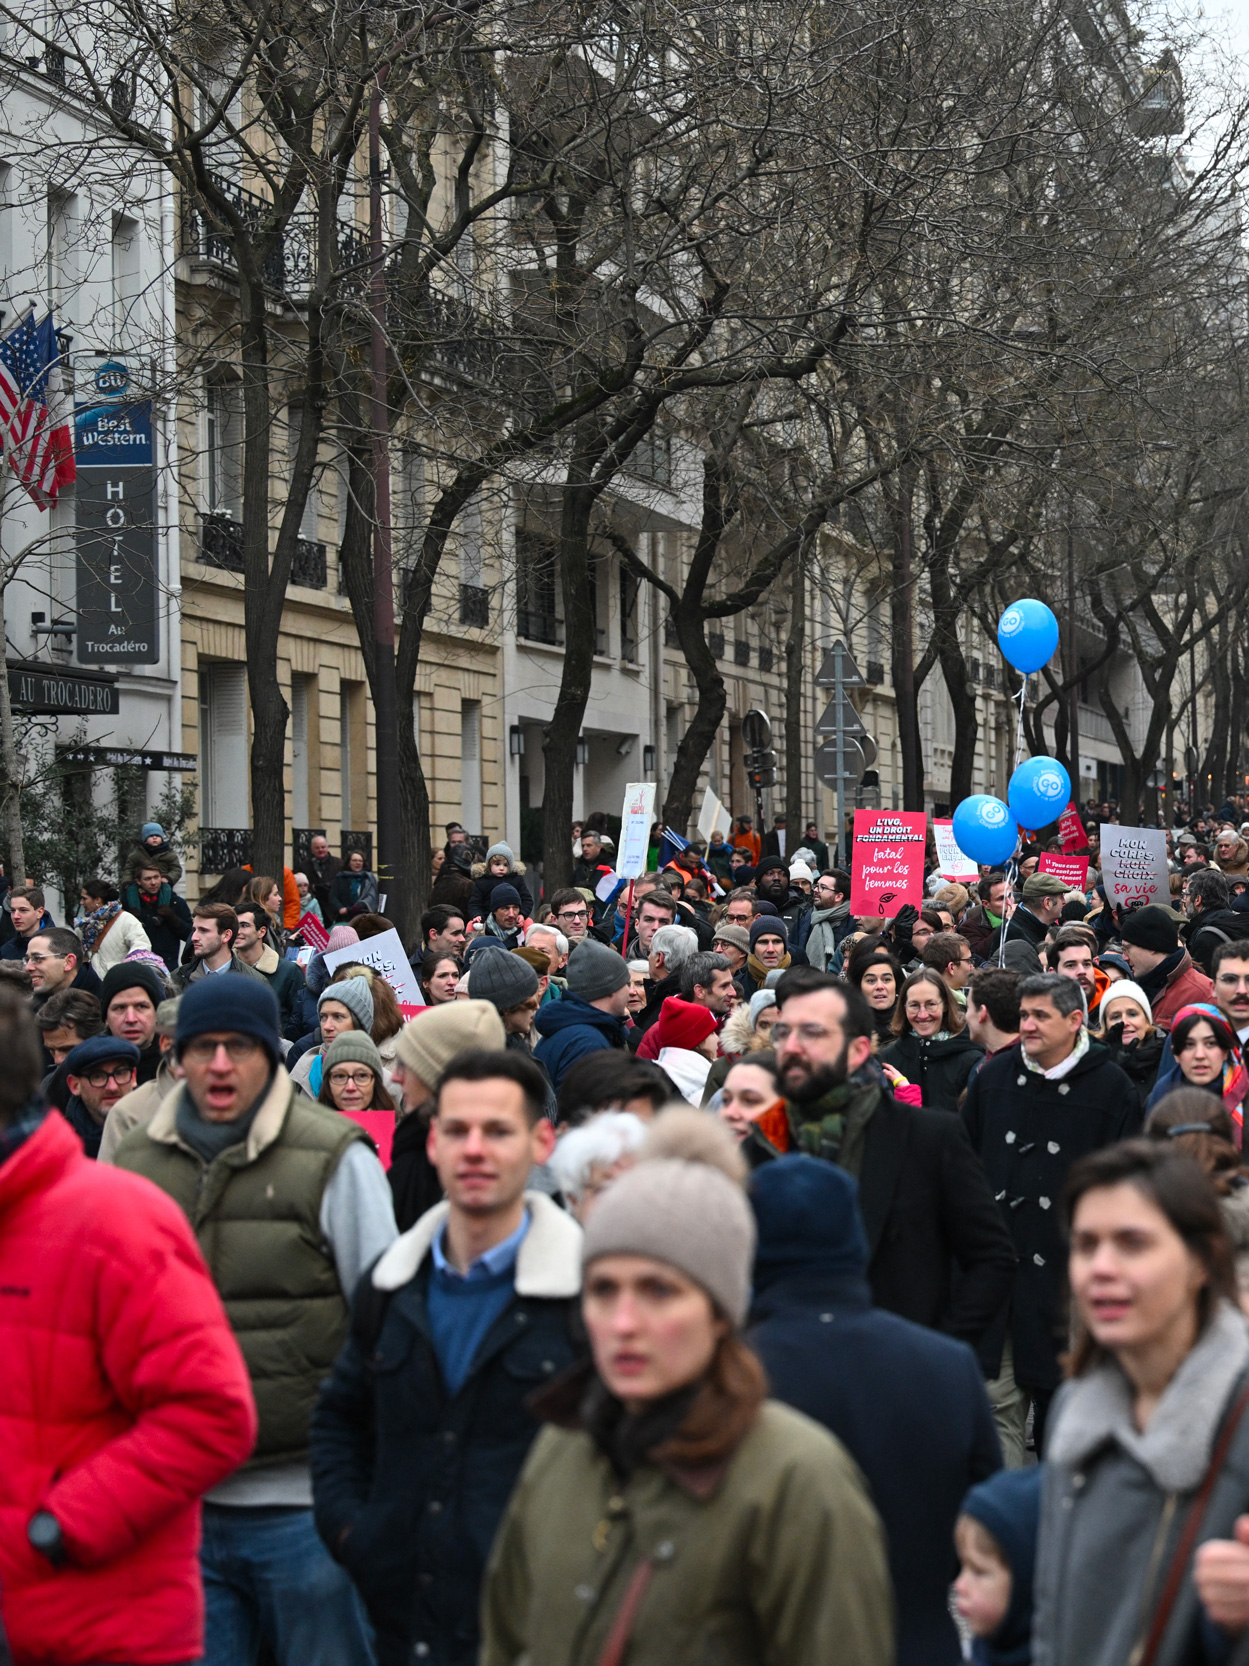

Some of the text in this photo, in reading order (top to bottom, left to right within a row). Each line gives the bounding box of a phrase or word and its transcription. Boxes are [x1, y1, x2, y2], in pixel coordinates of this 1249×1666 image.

[97, 417, 132, 431] Best
[82, 432, 146, 446] Western
[106, 480, 125, 613] HOTEL
[108, 625, 126, 635] Au
[86, 640, 148, 653] Trocadéro
[20, 677, 112, 713] AU TROCADERO
[1041, 779, 1059, 791] GO
[986, 805, 1001, 819] GO
[876, 818, 902, 826] L'IVG,
[869, 826, 912, 834] UN DROIT
[856, 834, 924, 842] FONDAMENTAL
[1118, 838, 1148, 850] MON
[873, 846, 904, 862] fatal
[1110, 848, 1157, 862] CORPS,
[861, 861, 910, 879] pour les
[1119, 860, 1149, 870] MON
[1114, 869, 1155, 880] CHOIX
[865, 876, 909, 891] femmes
[1114, 882, 1158, 895] sa vie
